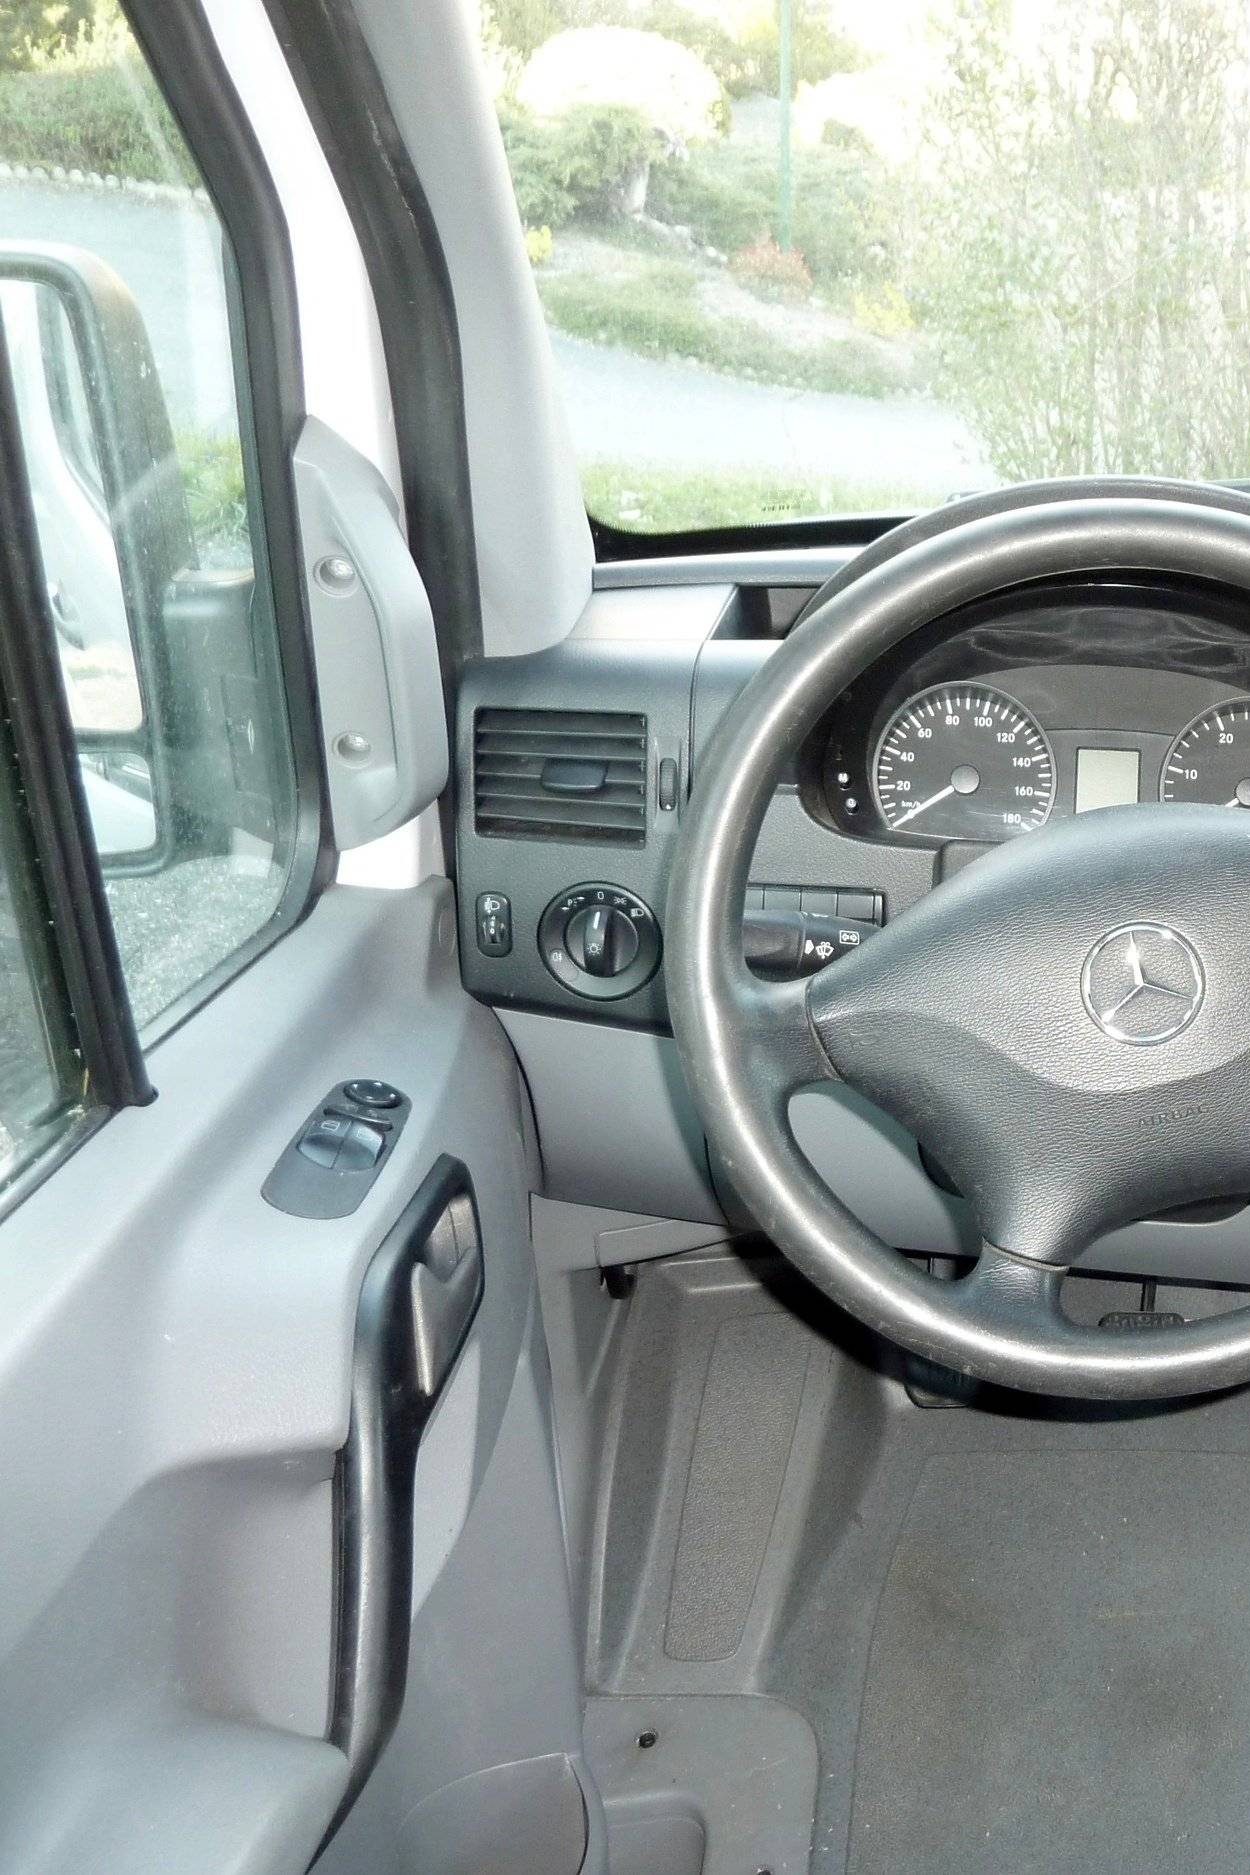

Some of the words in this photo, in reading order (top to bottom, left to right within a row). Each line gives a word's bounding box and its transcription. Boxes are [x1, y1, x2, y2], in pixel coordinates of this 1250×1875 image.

[945, 715, 960, 726] 80
[973, 716, 993, 727] 100
[917, 728, 933, 739] 60
[996, 732, 1016, 743] 120
[1218, 732, 1234, 744] 20
[900, 751, 915, 762] 40
[1012, 757, 1031, 767] 140
[1184, 769, 1198, 780] 10
[896, 781, 911, 791] 20
[1014, 785, 1033, 796] 160
[1003, 813, 1021, 824] 180
